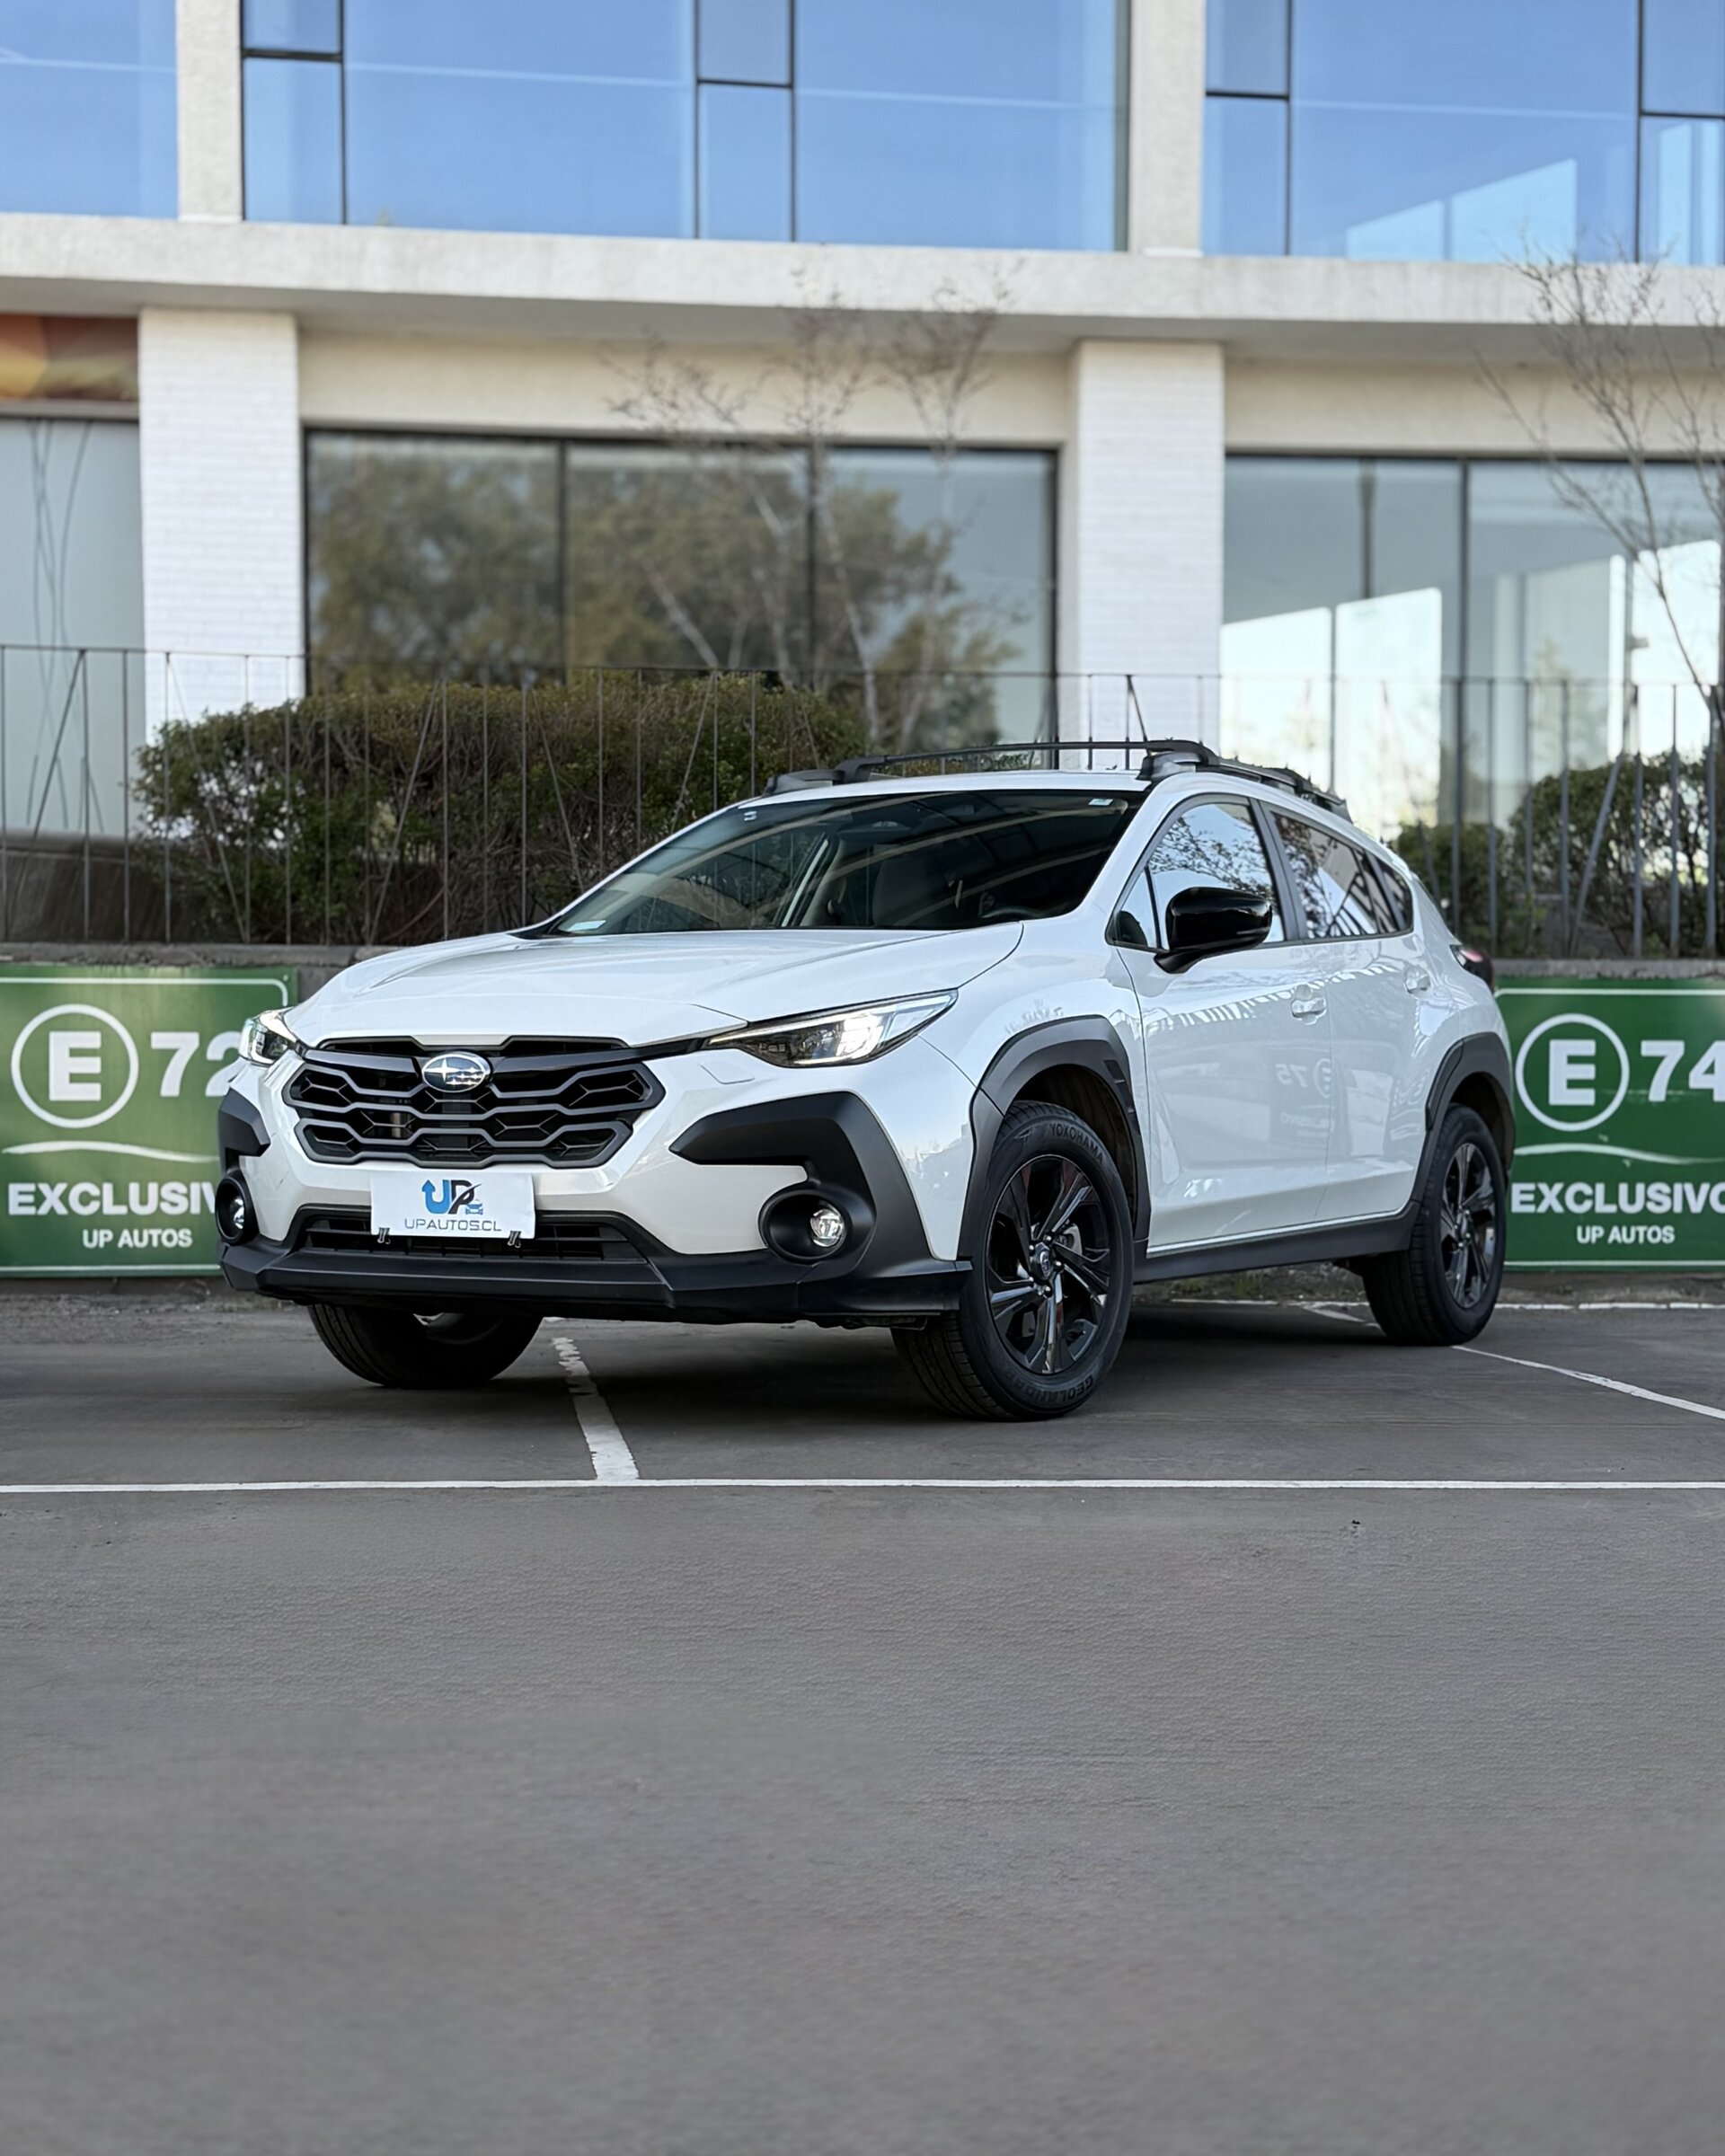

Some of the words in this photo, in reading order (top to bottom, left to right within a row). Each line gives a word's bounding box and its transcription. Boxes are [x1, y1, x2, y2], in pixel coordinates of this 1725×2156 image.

[49, 1030, 102, 1101] E
[1548, 1039, 1597, 1106] E
[1641, 1040, 1725, 1102] 74
[1049, 1122, 1104, 1163] YOKOHAMA
[83, 1228, 113, 1248] UP
[118, 1228, 192, 1248] AUTOS
[1577, 1225, 1604, 1243] UP
[1607, 1225, 1676, 1243] AUTOS
